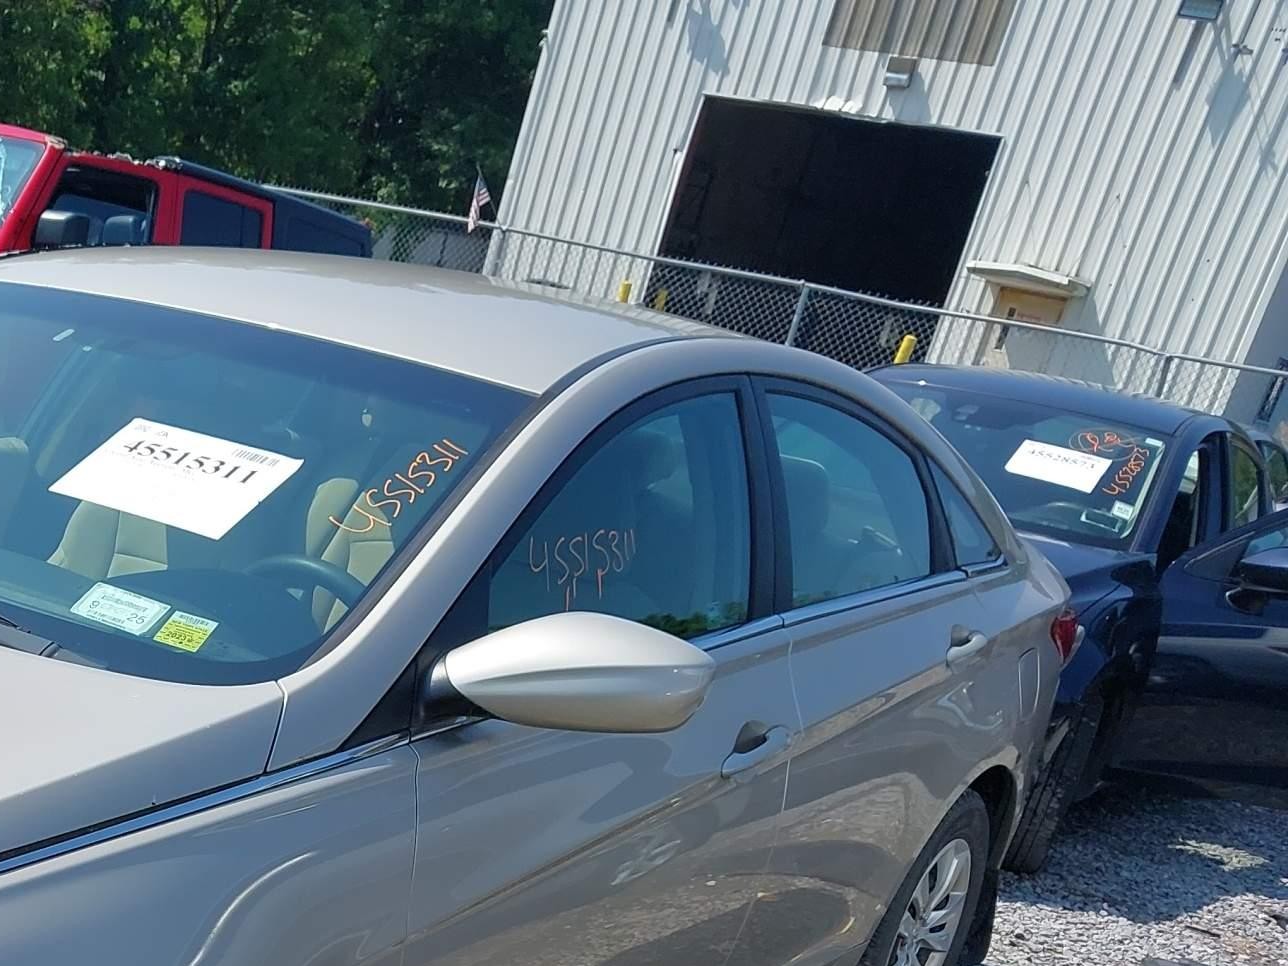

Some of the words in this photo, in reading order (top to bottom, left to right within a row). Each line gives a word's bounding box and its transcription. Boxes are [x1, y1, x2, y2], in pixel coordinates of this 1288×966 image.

[123, 440, 259, 484] 45515311
[328, 438, 469, 533] 45515311
[529, 528, 636, 592] 45515311
[126, 613, 148, 625] 25
